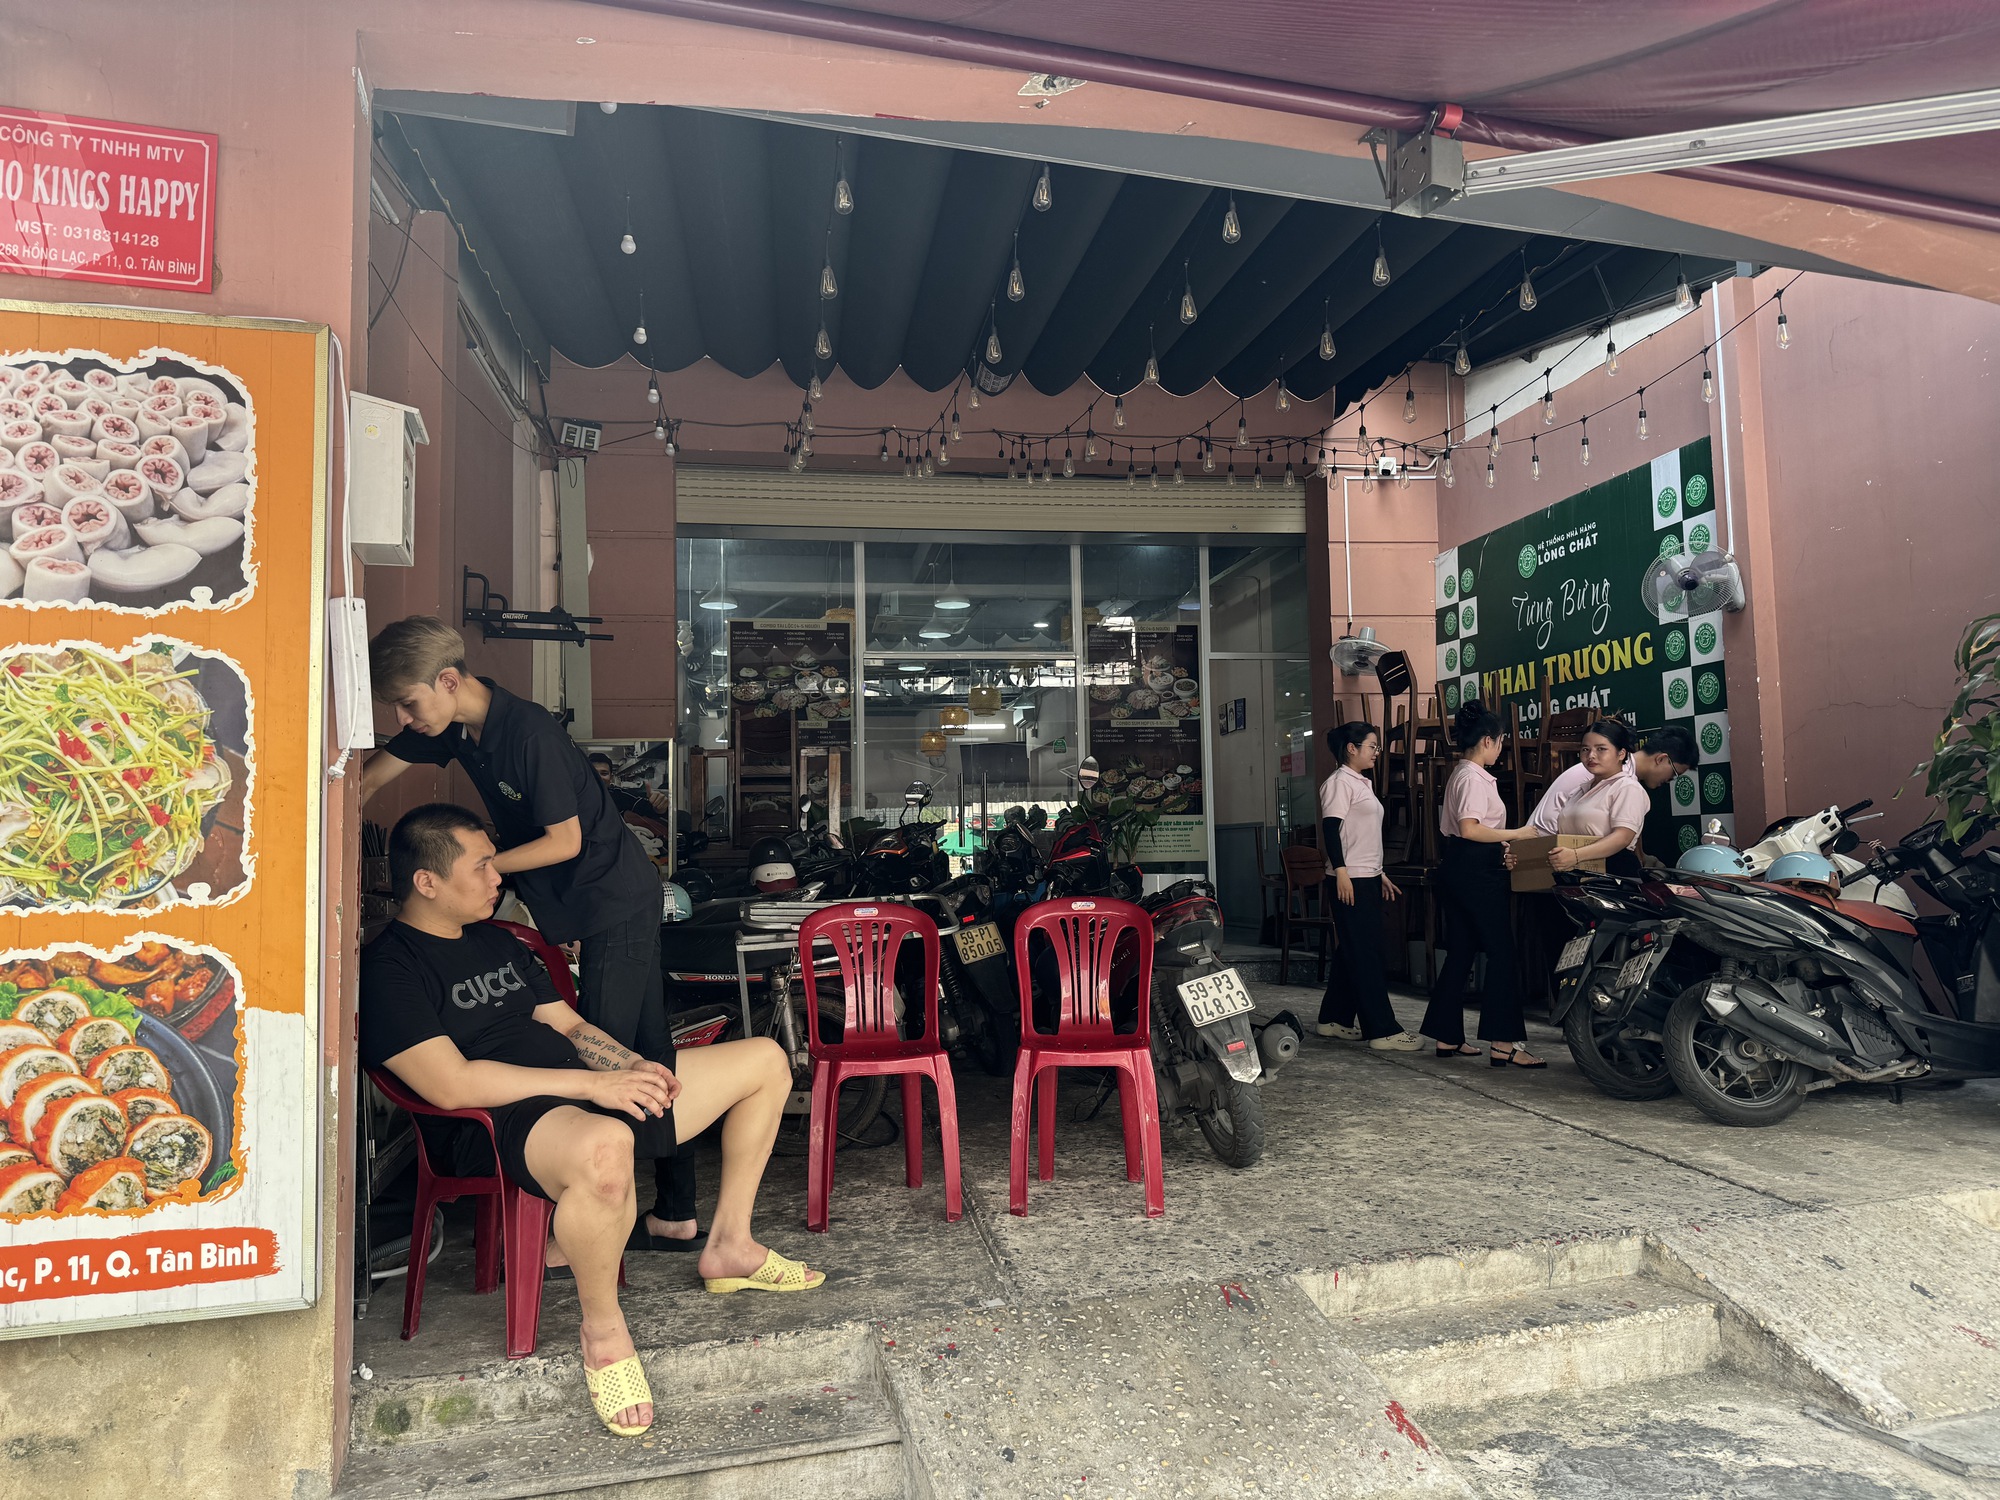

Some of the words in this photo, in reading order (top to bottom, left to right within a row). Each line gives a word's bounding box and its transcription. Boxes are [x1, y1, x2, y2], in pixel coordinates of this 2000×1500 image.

[0, 123, 54, 147] CÔNG
[60, 133, 84, 151] TY
[90, 137, 140, 158] TNHH
[146, 145, 185, 163] MTV
[32, 163, 110, 212] KINGS
[118, 174, 200, 222] HAPPY
[15, 219, 57, 237] MST:
[63, 225, 160, 248] 0318314128
[22, 240, 58, 261] HỒNG
[61, 249, 90, 266] LẠC,
[92, 252, 102, 266] P.
[105, 254, 121, 269] 11,
[125, 256, 138, 269] Q.
[141, 255, 165, 272] TÂN
[168, 259, 196, 276] BÌNH
[1566, 527, 1578, 540] NHÀ
[1579, 521, 1597, 533] HÀNG
[1537, 545, 1565, 566] LÒNG
[1569, 532, 1598, 553] CHÁT
[1512, 591, 1555, 650] Tưng
[1560, 578, 1611, 635] Bừng
[1483, 661, 1536, 698] KHAI
[1543, 632, 1654, 686] TRƯƠNG
[960, 926, 992, 945] 59-P1
[962, 939, 1002, 961] 850.05
[1186, 974, 1234, 1001] 59-P3
[1191, 990, 1250, 1022] 048.13
[570, 1030, 581, 1040] Do
[582, 1035, 605, 1047] what
[600, 1043, 619, 1053] you
[577, 1047, 597, 1060] what
[595, 1054, 612, 1067] you
[34, 1257, 61, 1285] P.
[67, 1255, 100, 1286] 11,
[105, 1250, 140, 1279] Q.
[146, 1247, 193, 1275] Tân
[200, 1239, 258, 1270] Bình
